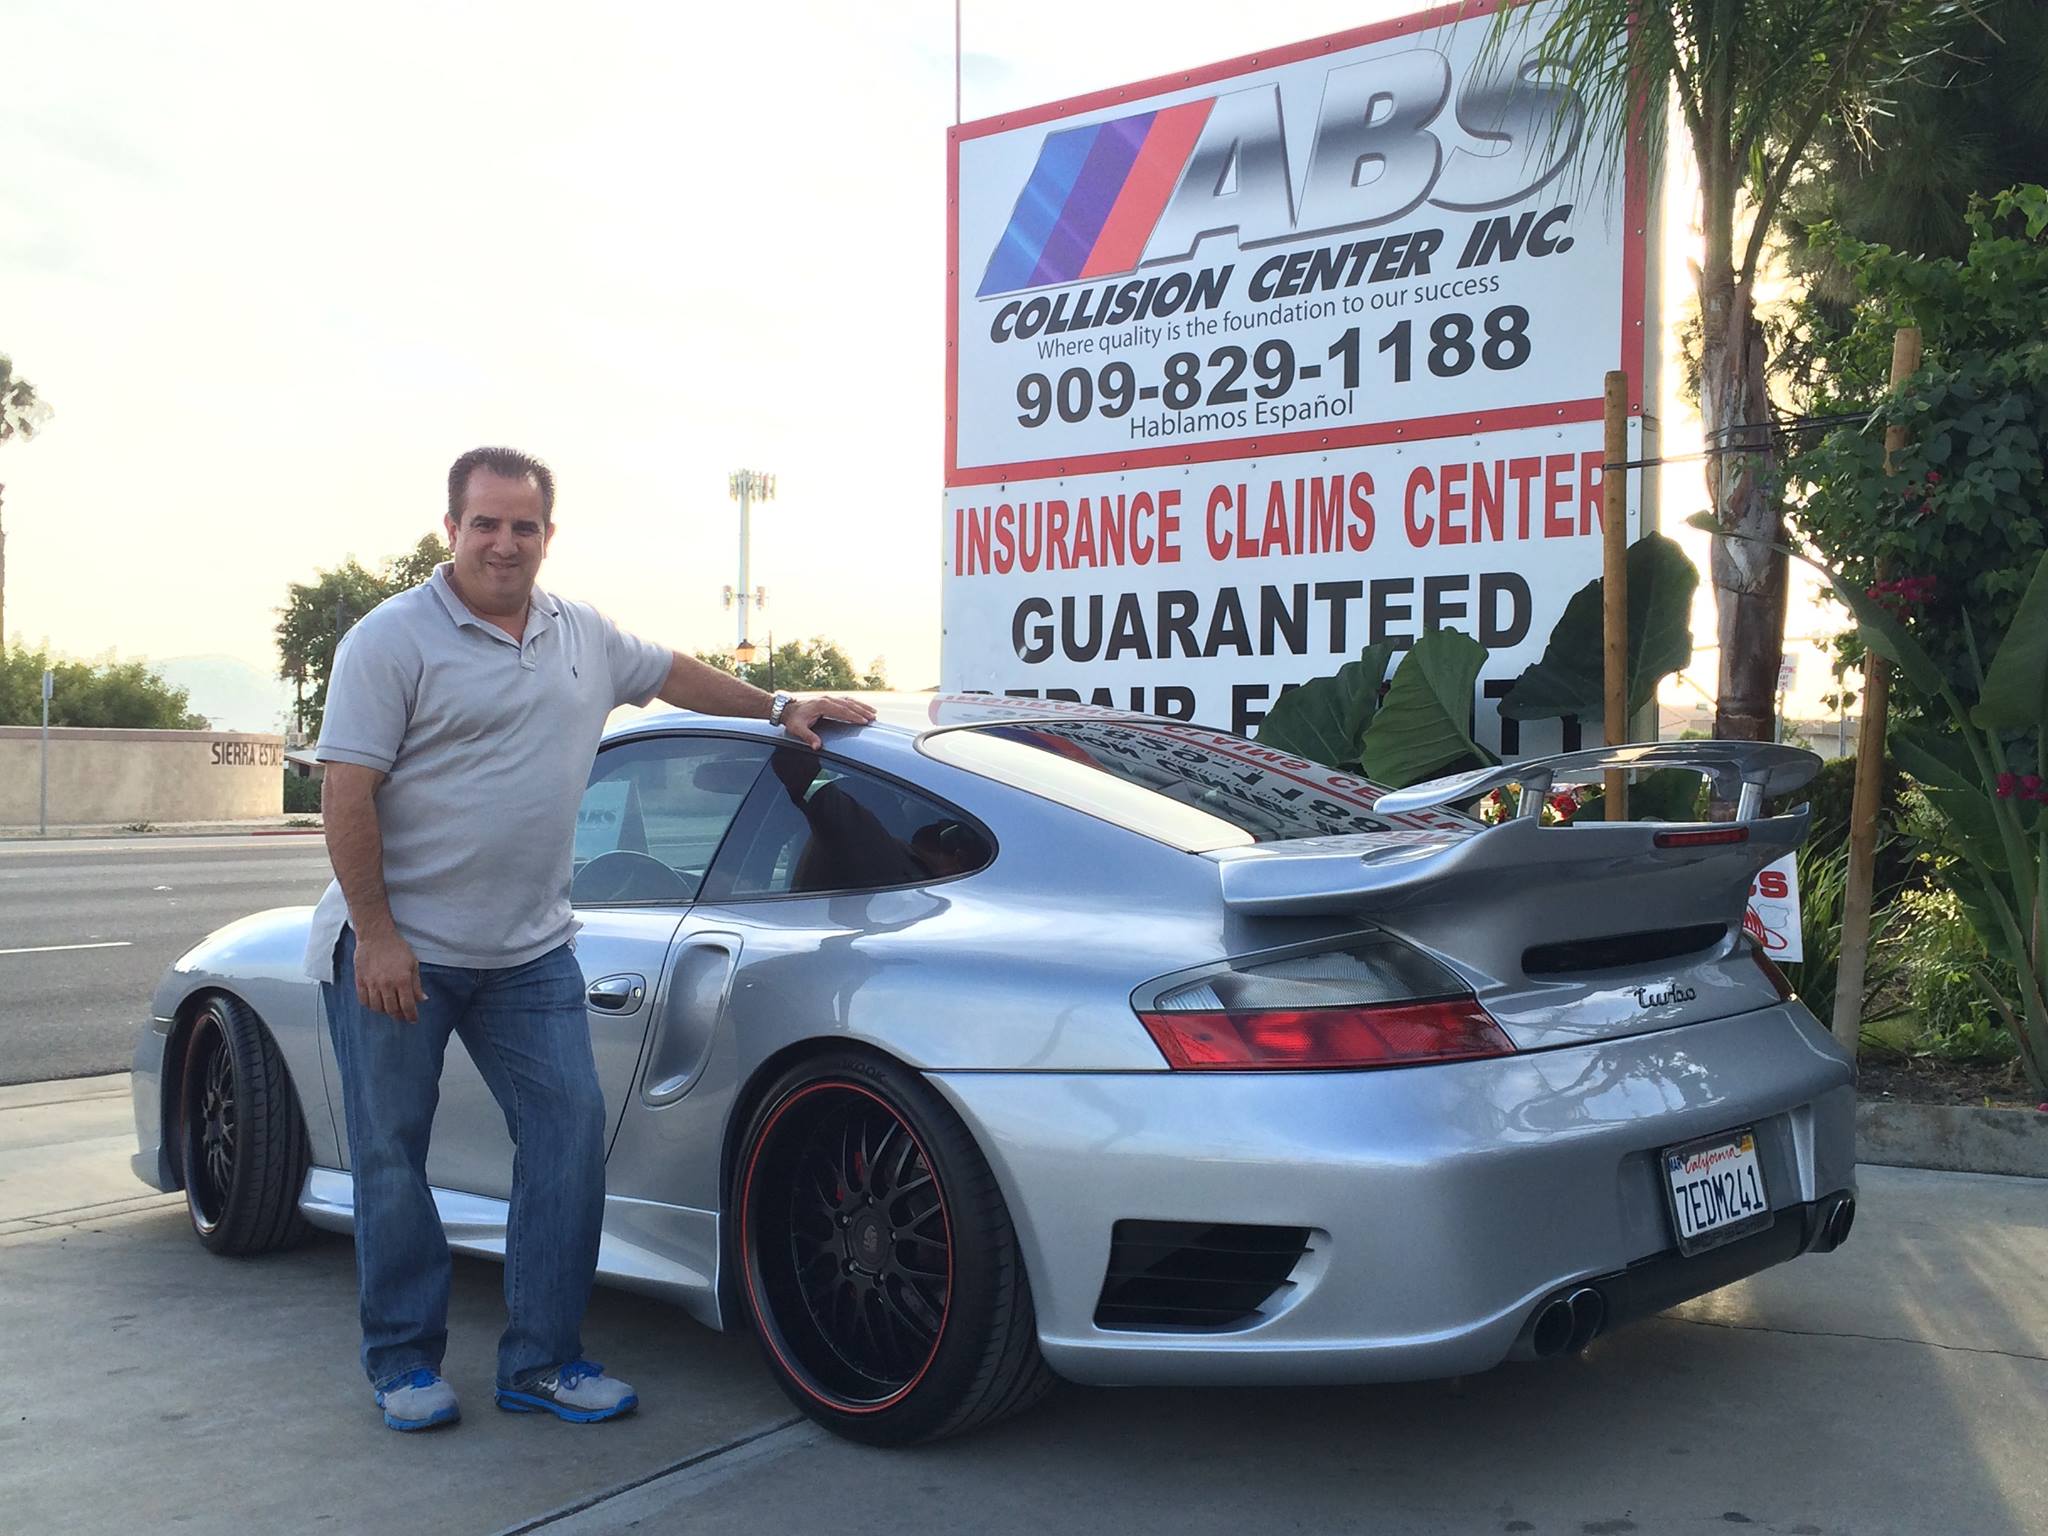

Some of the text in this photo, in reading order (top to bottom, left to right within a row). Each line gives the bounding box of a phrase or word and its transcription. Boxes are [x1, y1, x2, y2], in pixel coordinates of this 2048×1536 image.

[1138, 10, 1586, 269] ABS
[989, 203, 1575, 344] COLLISION CENTER INC.
[1037, 274, 1500, 361] Where quality is the foundation to our success
[1016, 304, 1532, 429] 909-829-1188
[1130, 389, 1354, 440] Hablamos Español
[955, 450, 1605, 577] INSURANCE CLAIMS CENTER
[1012, 571, 1533, 665] GUARANTEED
[211, 742, 256, 766] SIERRA
[1676, 1165, 1764, 1233] 7EDM241
[1684, 1147, 1742, 1176] California
